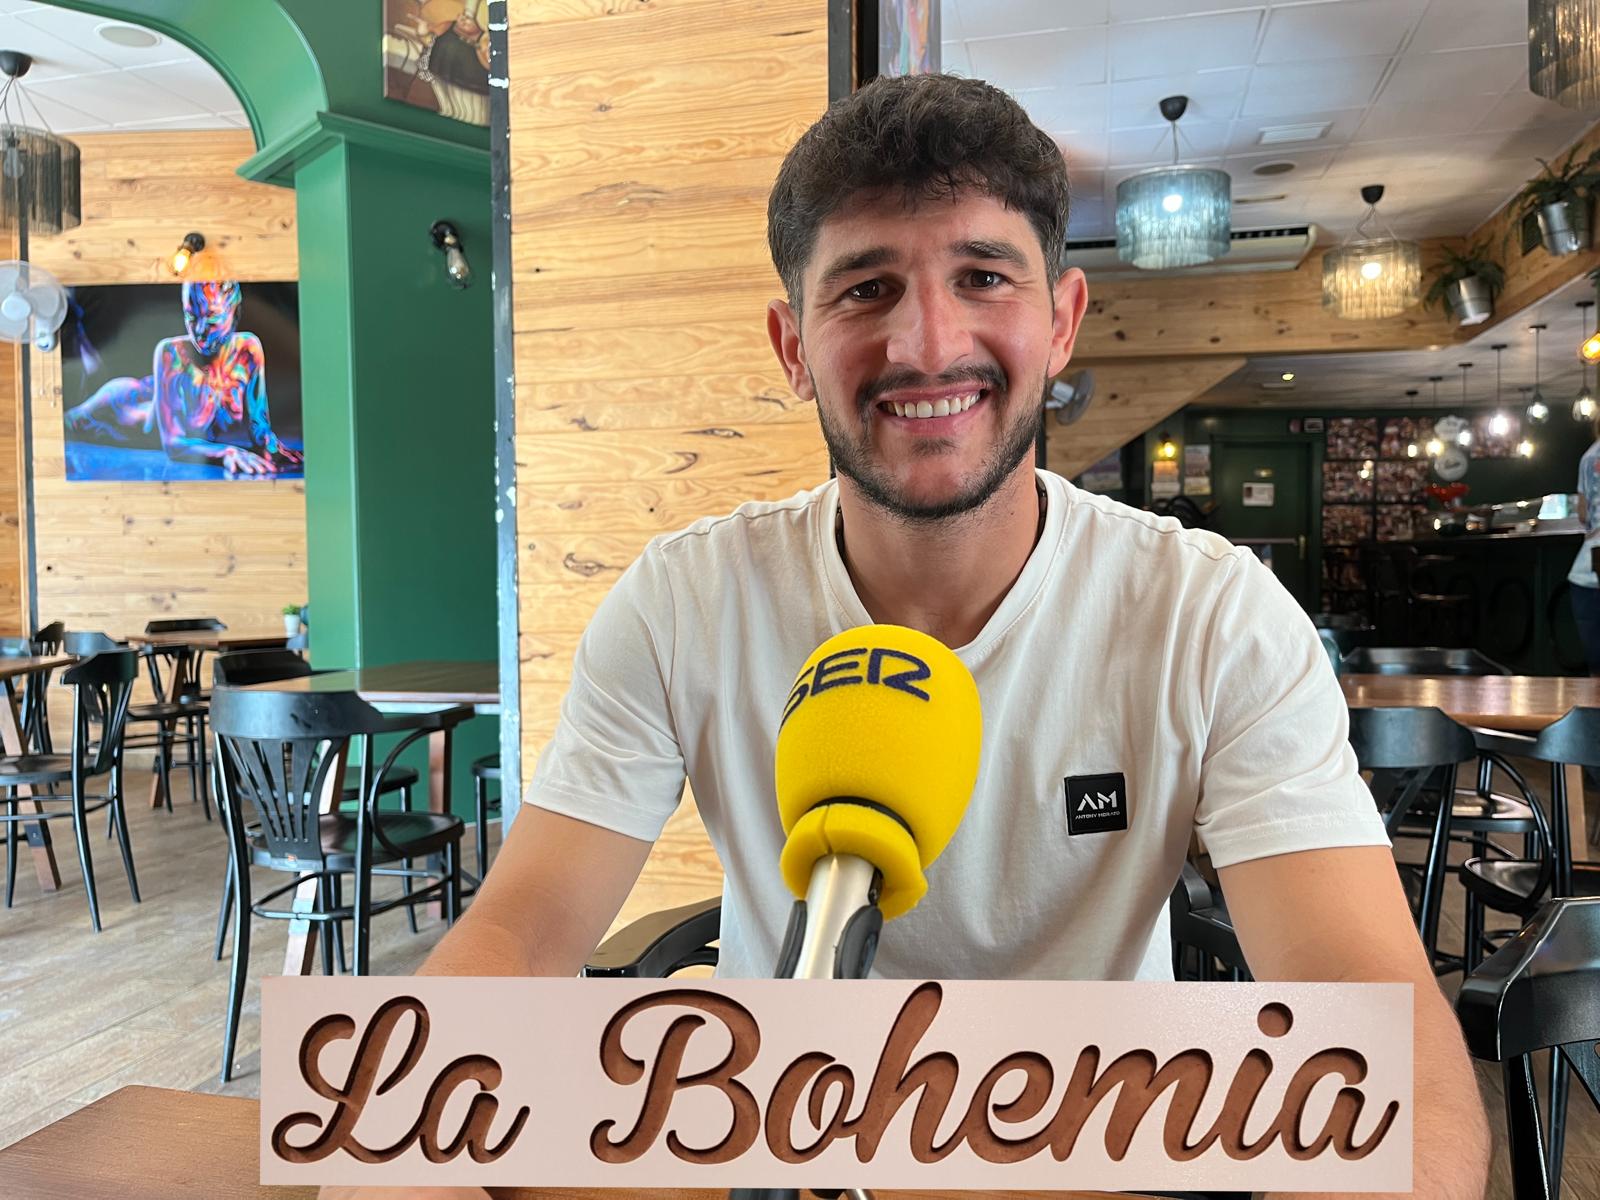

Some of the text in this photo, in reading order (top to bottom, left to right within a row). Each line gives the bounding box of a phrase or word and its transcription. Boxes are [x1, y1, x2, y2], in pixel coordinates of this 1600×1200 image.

[777, 648, 931, 736] SER
[1077, 790, 1117, 811] AM
[271, 981, 1400, 1165] La Bohemia
